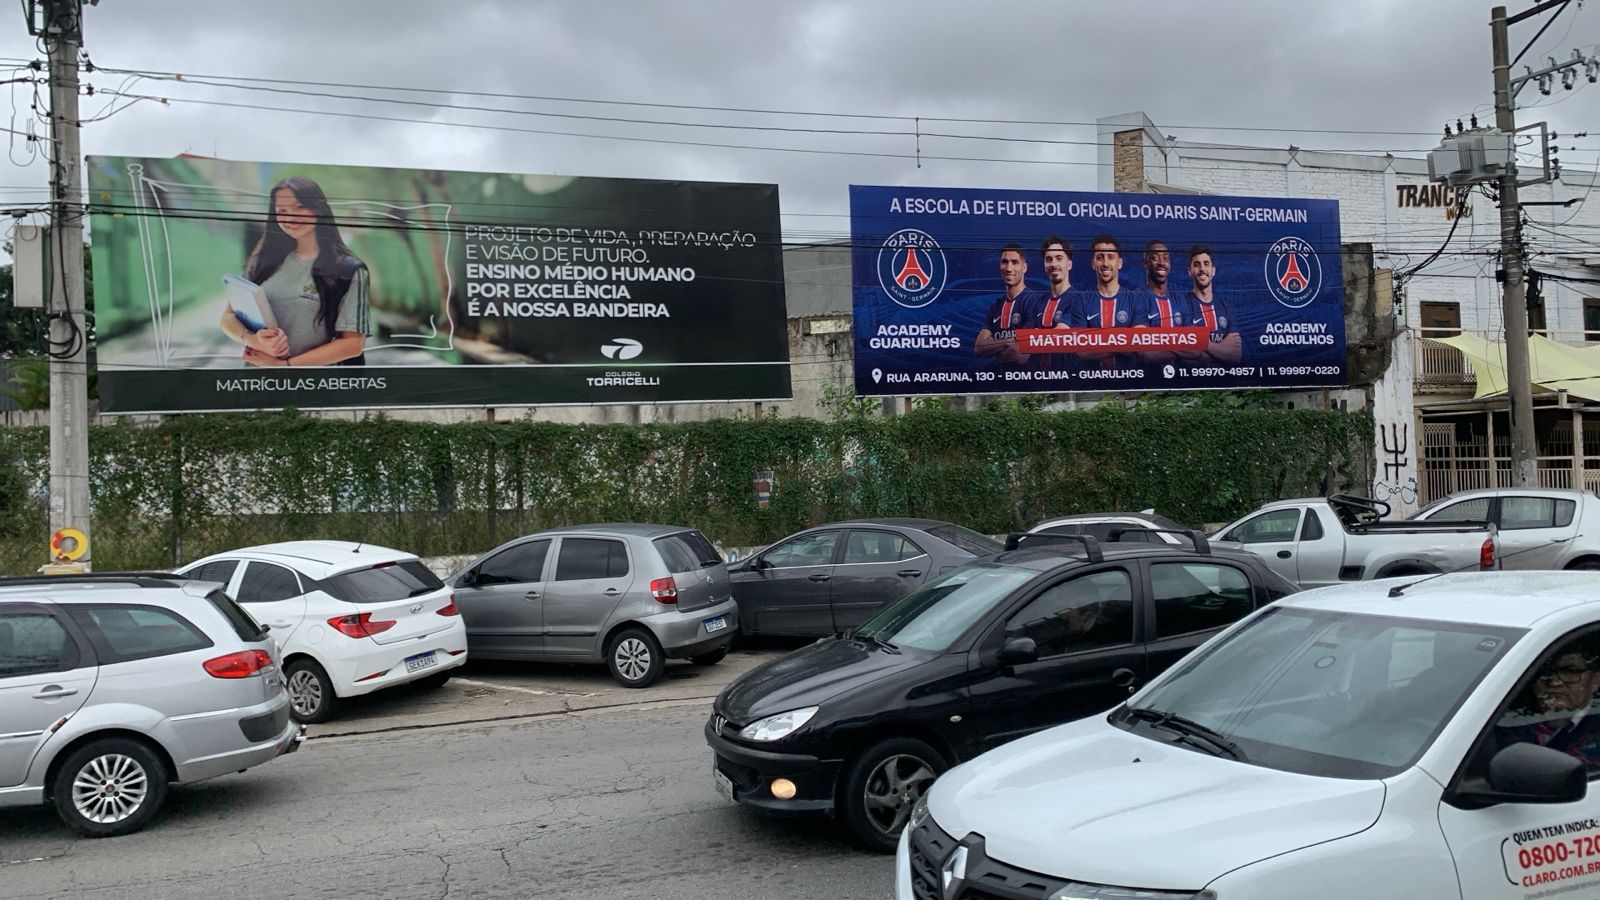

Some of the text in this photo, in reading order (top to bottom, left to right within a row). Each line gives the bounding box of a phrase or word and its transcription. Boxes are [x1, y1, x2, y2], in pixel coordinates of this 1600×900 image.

[889, 197, 1308, 223] A ESCOLA DE FUTEBOL OFICIAL DO PARIS SAINT-GERMAIN
[465, 225, 757, 250] PROJETO DE VIDA, PREPARAÇÃO
[888, 232, 934, 252] PARIS
[466, 242, 650, 264] E VISÃO DE FUTURO.
[1273, 240, 1311, 258] PARIS
[466, 262, 696, 283] ENSINO MÉDIO HUMANO
[467, 280, 631, 300] POR EXCELÊNCIA
[468, 299, 670, 318] É A NOSSA BANDEIRA
[877, 324, 952, 336] ACADEMY
[1266, 322, 1327, 334] ACADEMY
[869, 337, 961, 349] GUARULHOS
[1029, 332, 1198, 347] MATRÍCULAS ABERTAS
[1260, 334, 1335, 345] GUARULHOS
[886, 373, 911, 383] RUA
[913, 372, 973, 383] ARARUNA,
[975, 371, 995, 381] 130
[1005, 371, 1032, 381] BOM
[1033, 370, 1069, 381] CLIMA
[1078, 369, 1145, 380] GUARULHOS
[1179, 368, 1189, 377] 11.
[1191, 367, 1255, 377] 99970-4957
[1267, 367, 1277, 376] 11.
[1279, 366, 1340, 376] 99987-0220
[216, 376, 387, 391] MATRÍCULAS ABERTAS
[586, 377, 660, 387] TORRICELLI
[1512, 819, 1600, 846] QUEM TEM INDICA:
[1523, 862, 1600, 887] CLARO.COM.BR
